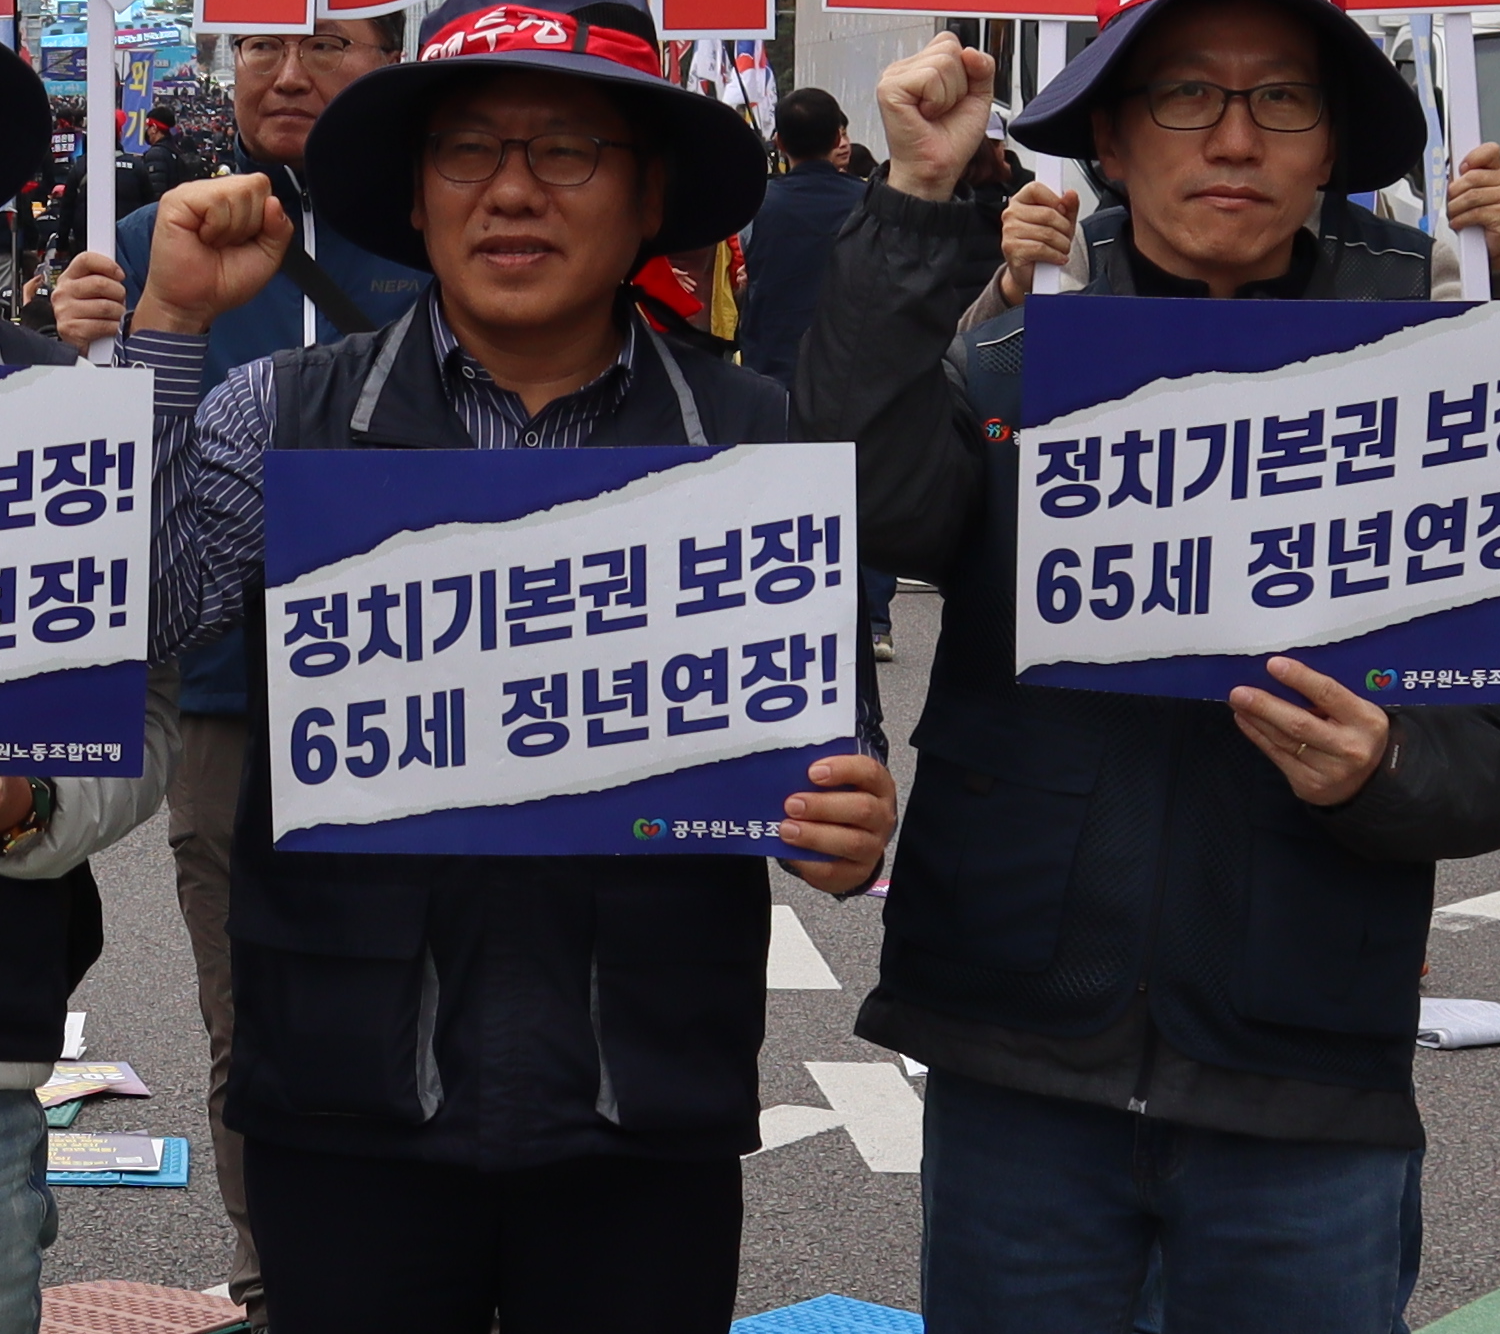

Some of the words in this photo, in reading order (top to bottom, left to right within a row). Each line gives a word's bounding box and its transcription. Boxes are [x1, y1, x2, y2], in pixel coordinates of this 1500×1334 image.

[371, 279, 420, 294] NEPA
[1036, 397, 1398, 518] 정치기본권
[284, 544, 647, 678] 정치기본권
[676, 514, 841, 617] 보장!
[1037, 536, 1212, 624] 65세
[291, 688, 465, 785] 65세
[502, 633, 837, 757] 정년연장!
[671, 820, 781, 840] 공무원노동조
